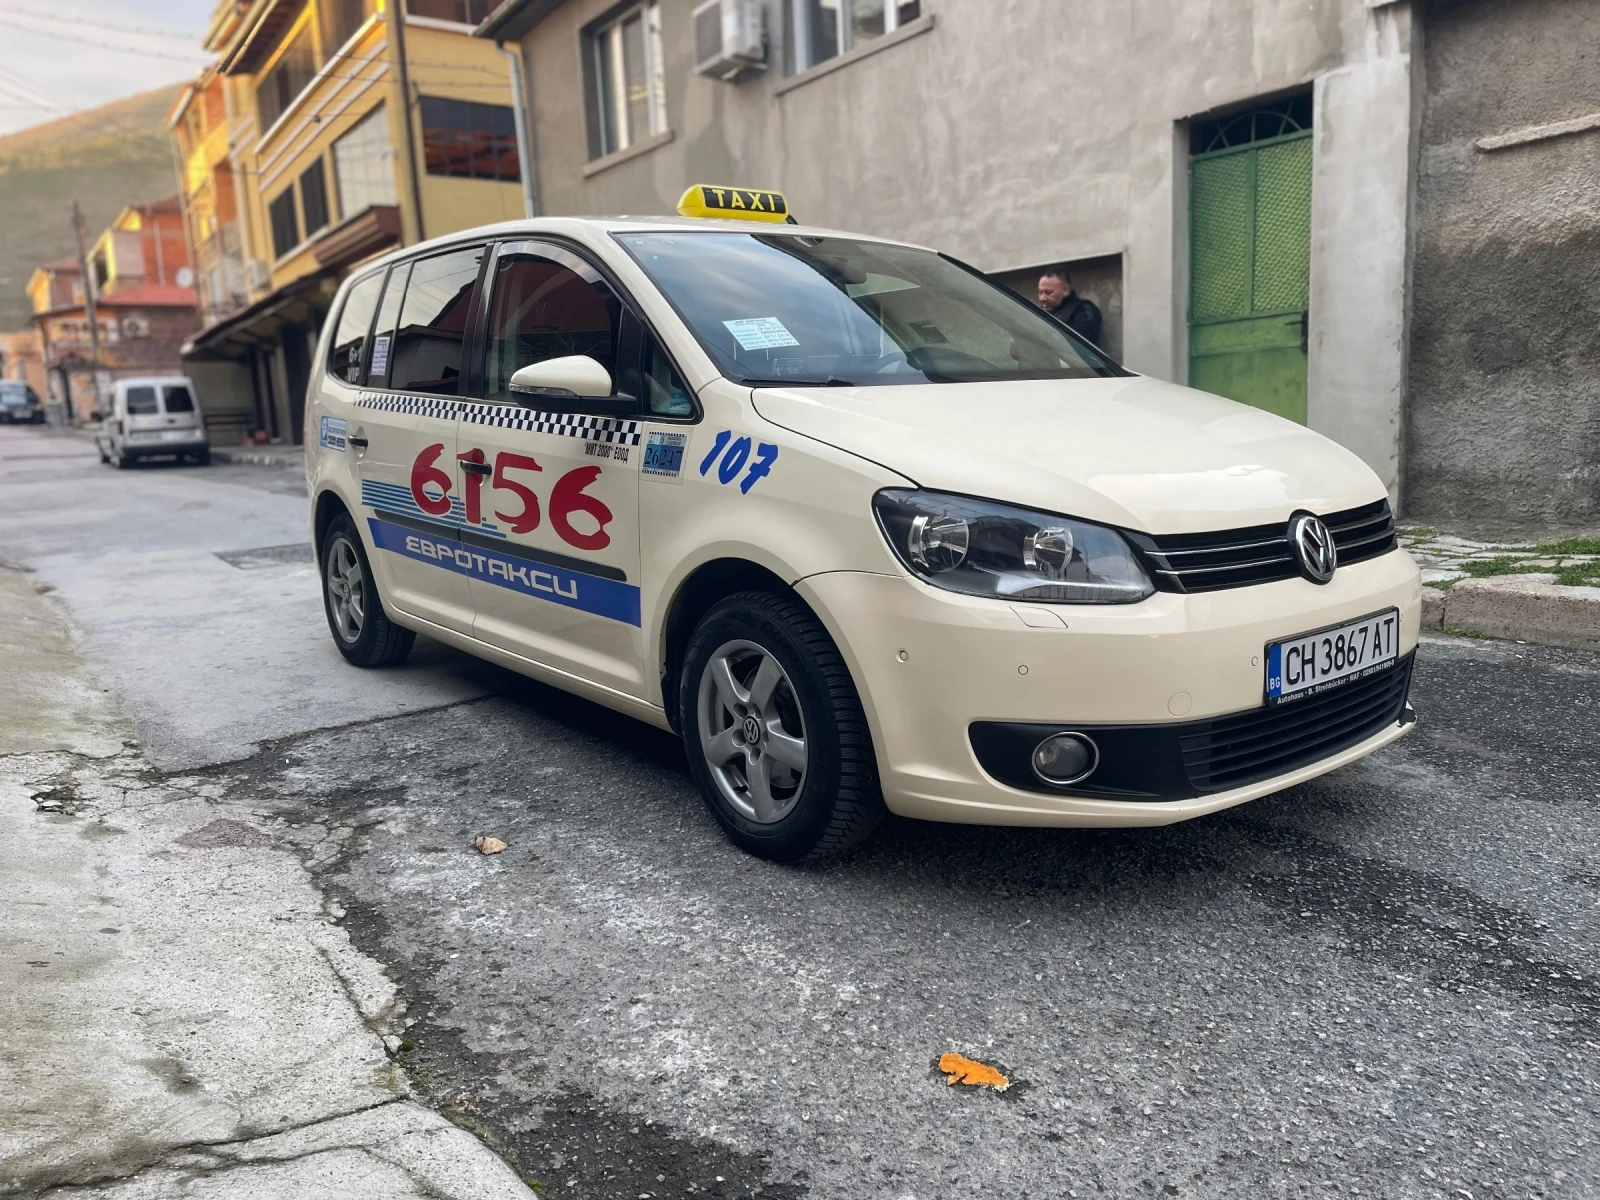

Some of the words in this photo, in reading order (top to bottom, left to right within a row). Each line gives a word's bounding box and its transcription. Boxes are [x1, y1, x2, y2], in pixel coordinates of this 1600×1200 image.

[711, 188, 776, 211] TAXI
[347, 367, 360, 382] VIP
[643, 446, 684, 467] 26247
[699, 429, 779, 495] 107
[410, 442, 614, 550] 6156
[405, 535, 578, 600] ЕВРОТАКСИ
[1320, 625, 1369, 675] 3867
[1269, 676, 1281, 690] BG
[1276, 690, 1304, 705] Autohaus
[1315, 678, 1347, 692] Strohbücker
